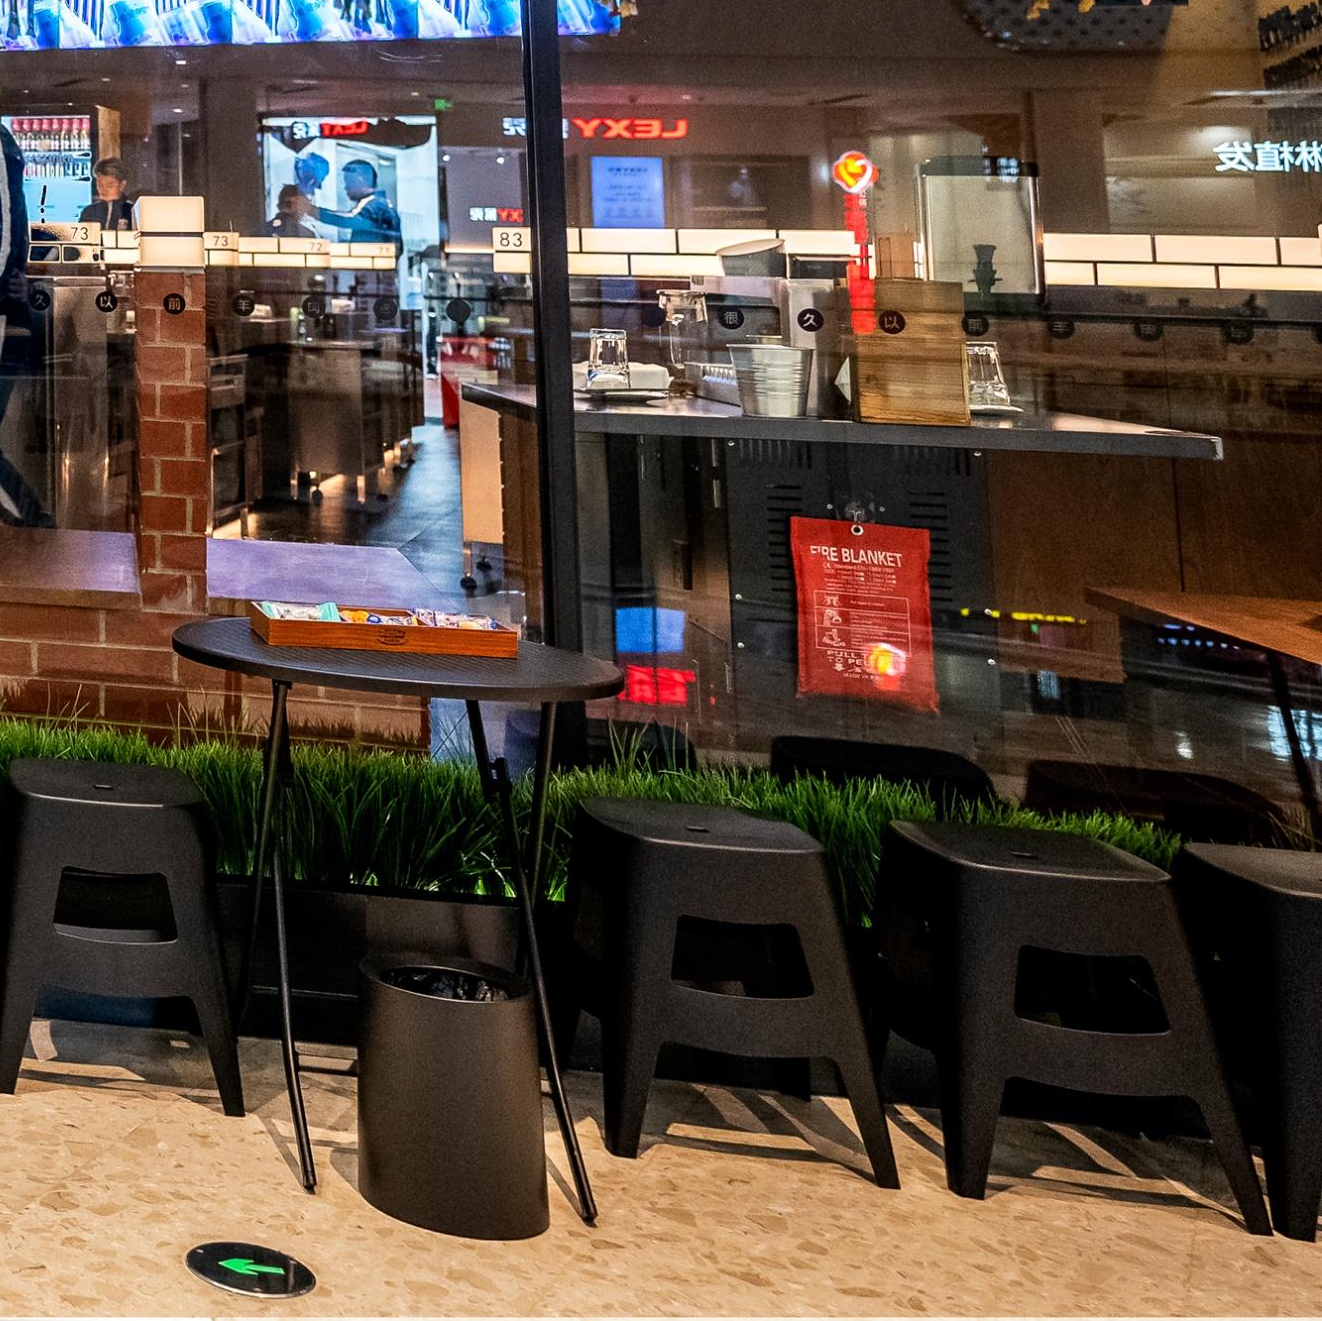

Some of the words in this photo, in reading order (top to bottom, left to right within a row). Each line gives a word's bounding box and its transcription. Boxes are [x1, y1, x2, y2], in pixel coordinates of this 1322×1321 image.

[70, 227, 89, 241] 73
[499, 232, 524, 247] 83
[212, 235, 229, 248] 73
[841, 547, 903, 567] BLANKET
